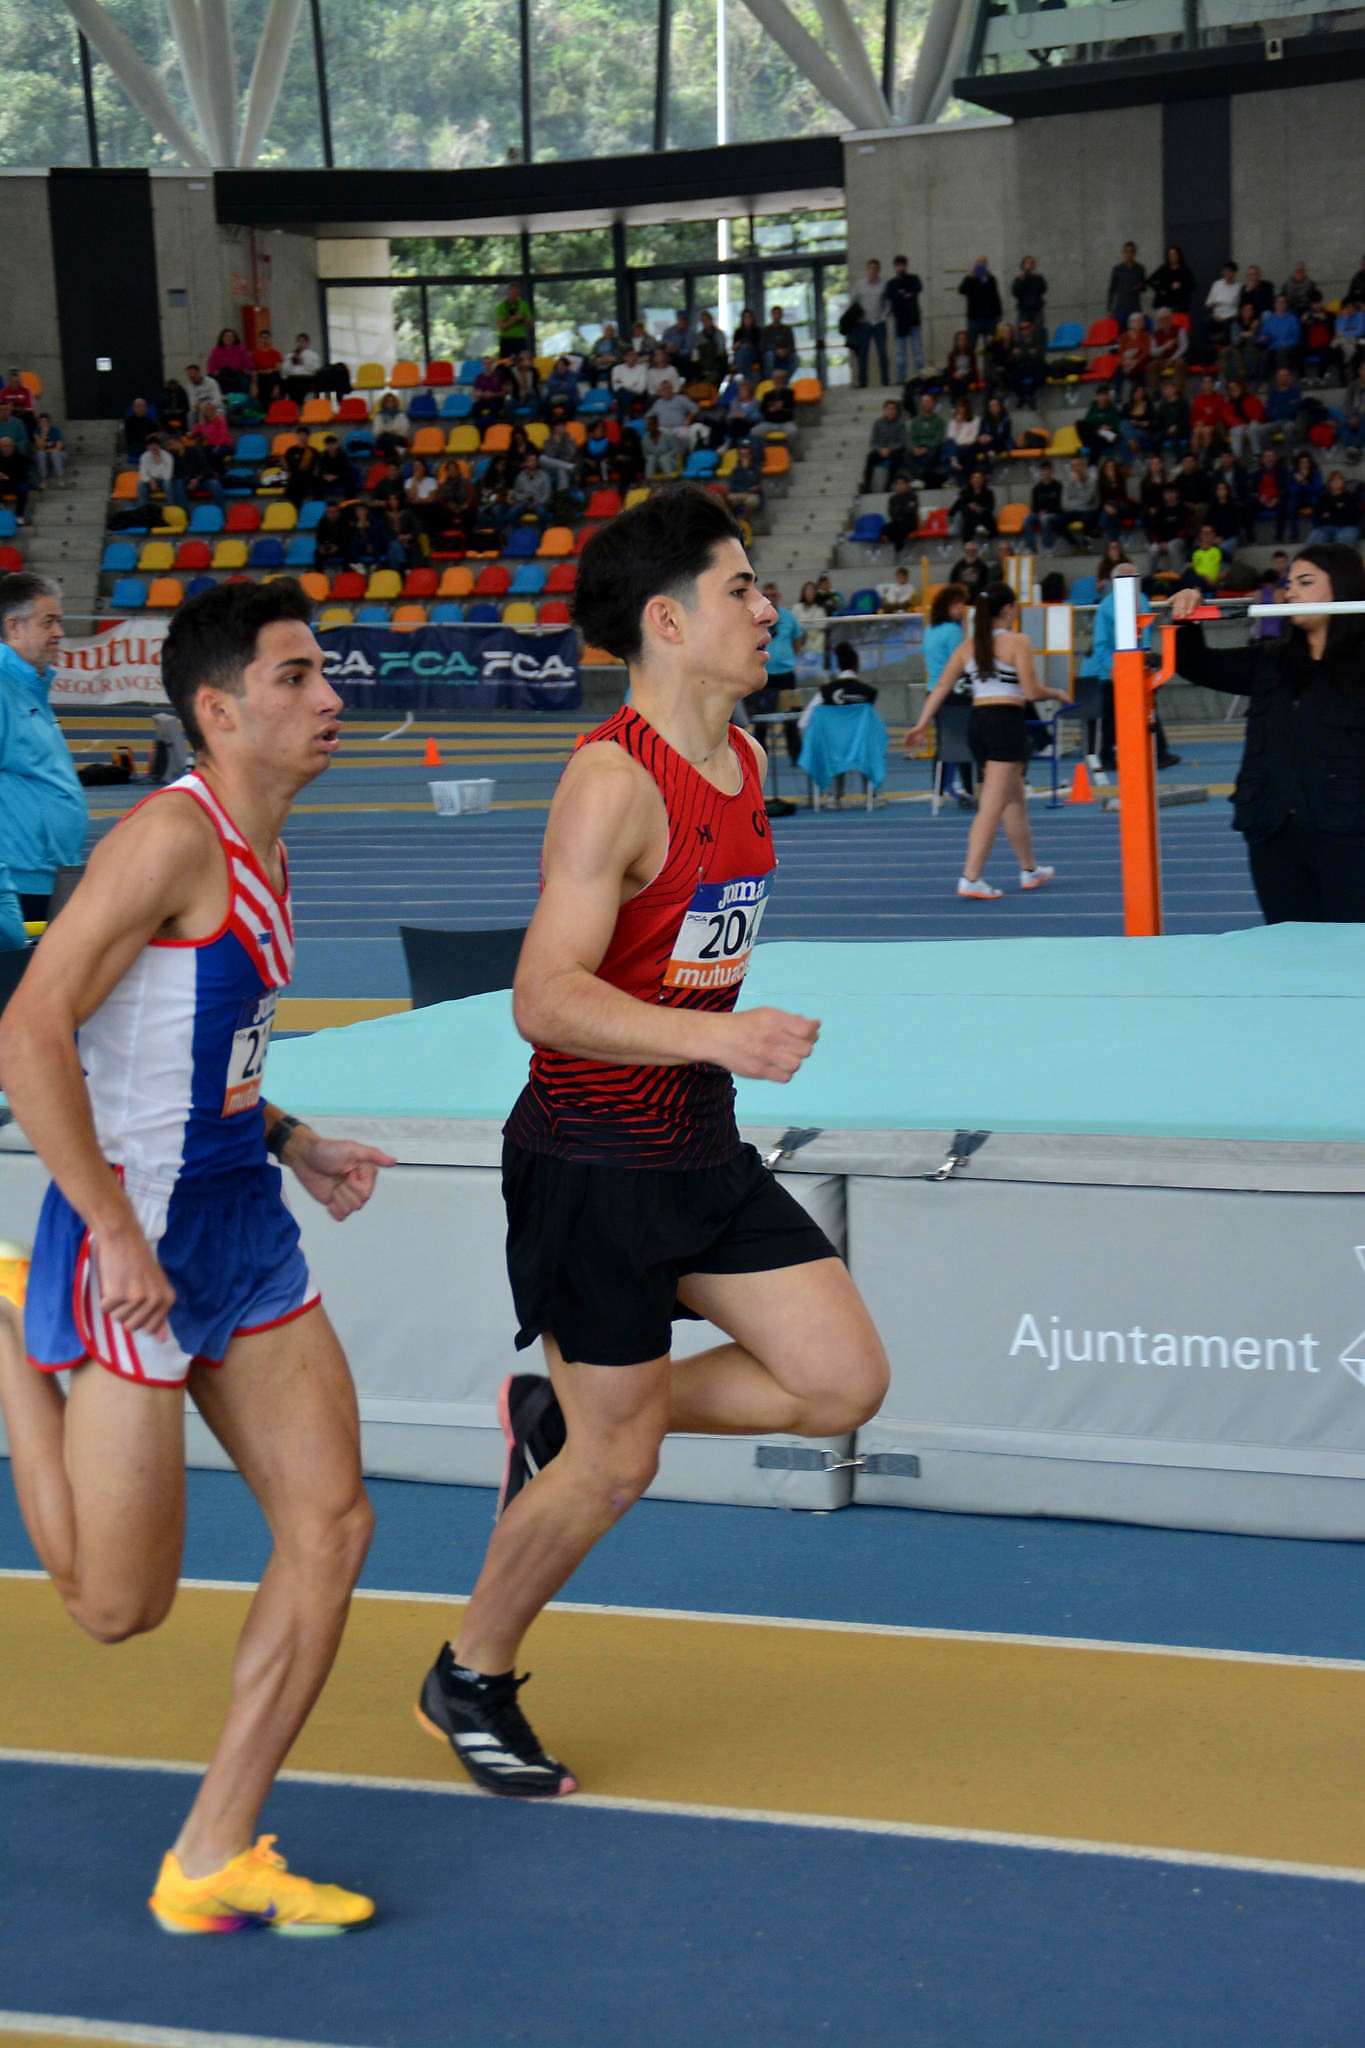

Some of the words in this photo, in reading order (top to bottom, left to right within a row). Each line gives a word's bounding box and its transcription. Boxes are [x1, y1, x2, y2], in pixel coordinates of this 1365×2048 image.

[323, 650, 376, 675] CA
[379, 650, 479, 676] FCA
[482, 651, 575, 678] FCA
[1008, 1313, 1321, 1373] Ajuntament
